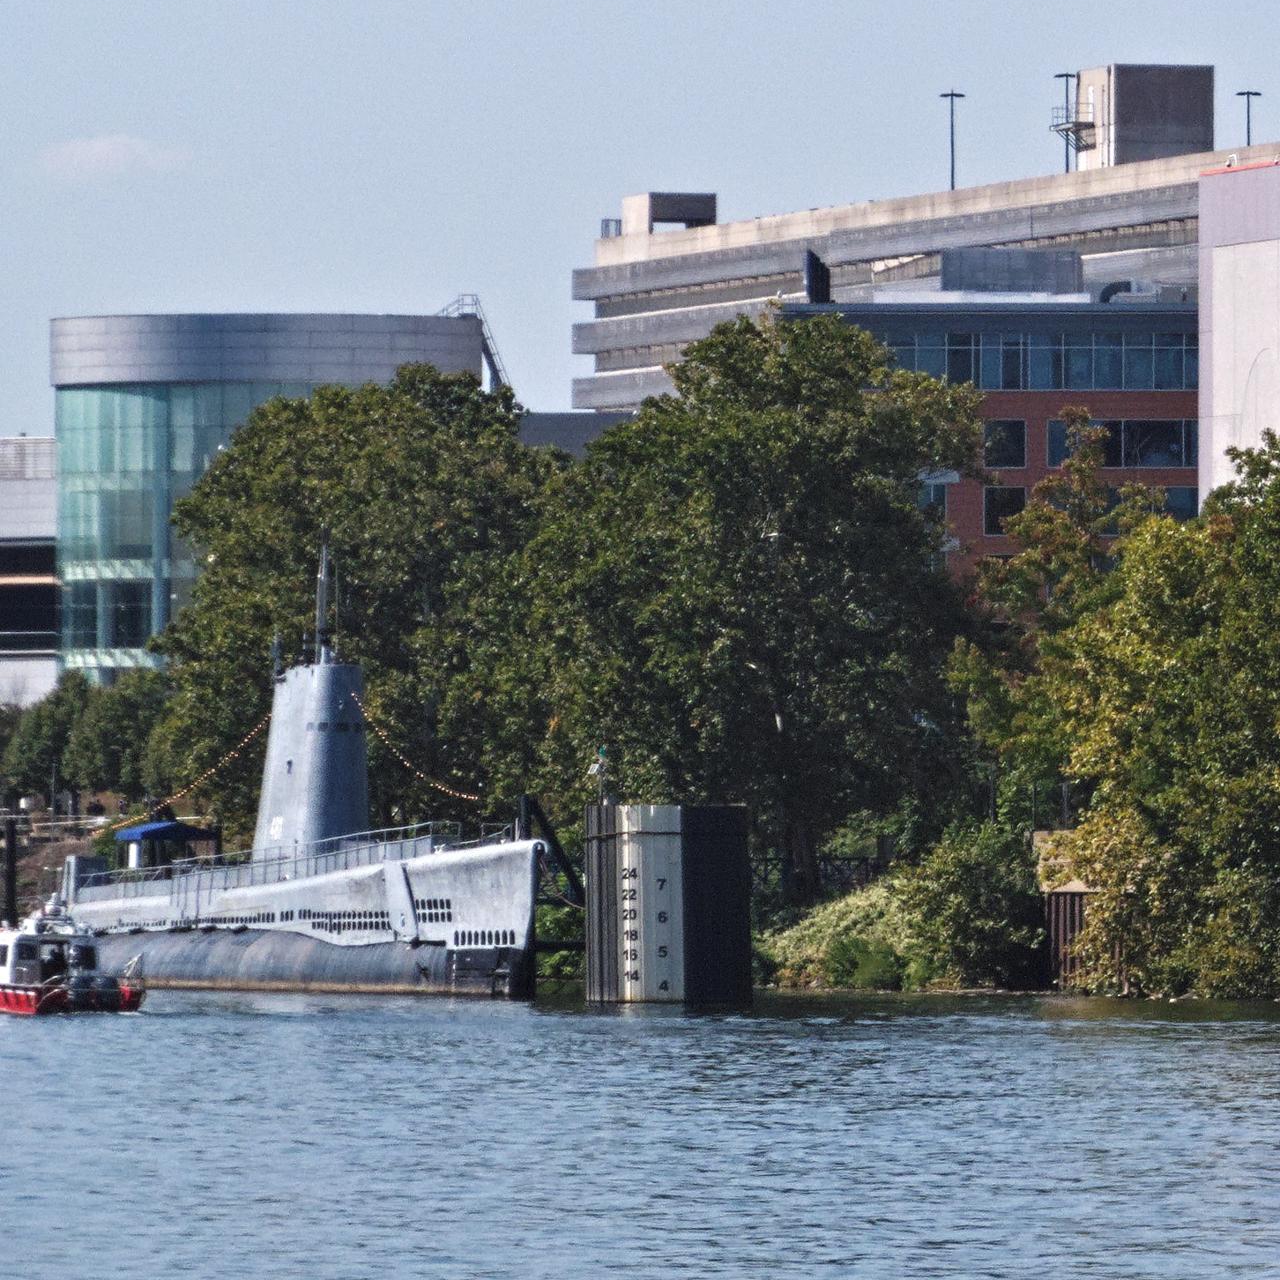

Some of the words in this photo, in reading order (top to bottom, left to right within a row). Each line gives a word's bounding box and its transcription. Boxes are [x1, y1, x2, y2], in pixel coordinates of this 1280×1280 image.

[621, 867, 638, 880] 24
[656, 878, 667, 891] 7
[621, 888, 638, 901] 22
[622, 908, 637, 921] 20
[657, 911, 668, 924] 6
[623, 929, 638, 941] 18
[622, 949, 638, 961] 16
[657, 945, 668, 958] 5
[623, 969, 640, 982] 14
[657, 979, 669, 992] 4
